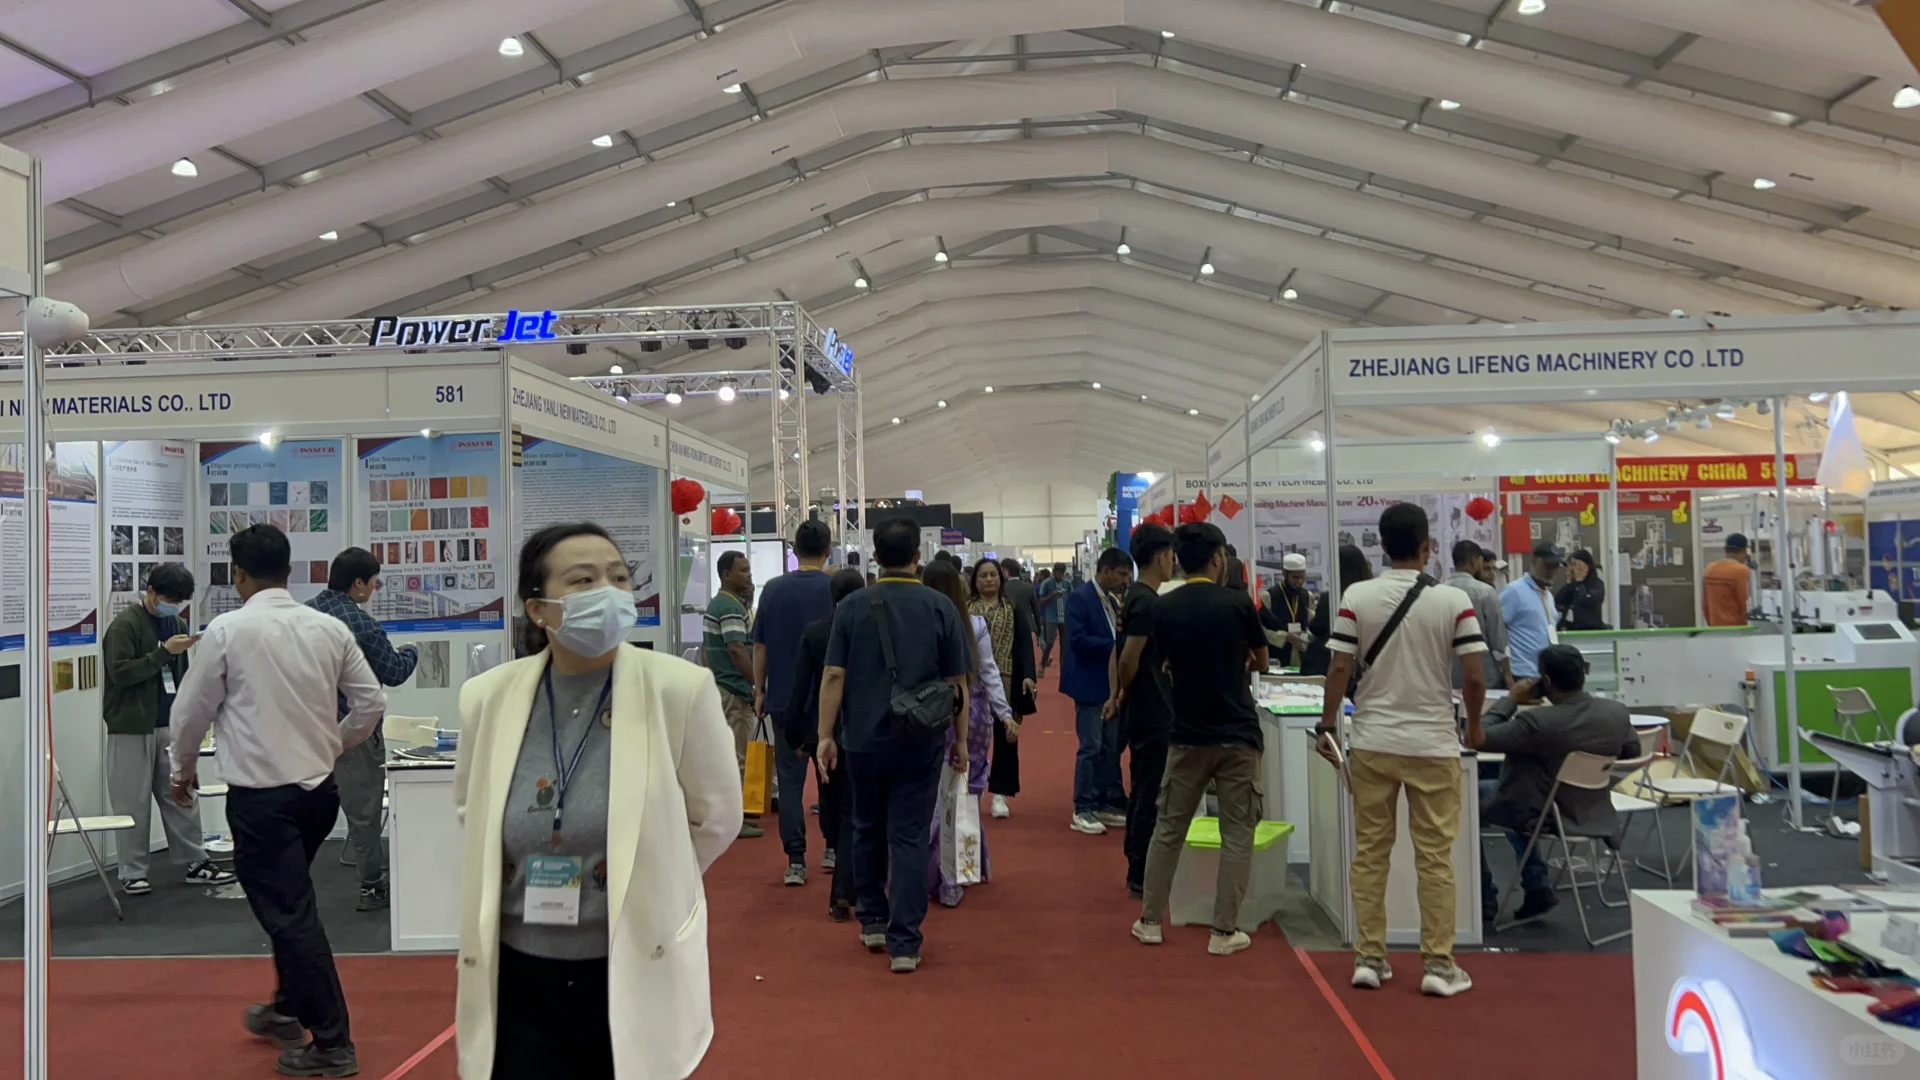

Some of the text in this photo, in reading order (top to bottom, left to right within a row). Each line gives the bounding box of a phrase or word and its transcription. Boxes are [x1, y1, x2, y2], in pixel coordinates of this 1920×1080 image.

[369, 309, 559, 346] Power Jet
[1349, 357, 1450, 377] ZHEJIANG
[1457, 354, 1530, 375] LIFENG
[1536, 350, 1658, 372] MACHINERY
[1664, 350, 1694, 368] CO
[52, 395, 152, 415] MATERIALS
[199, 393, 231, 411] LTD
[436, 385, 464, 403] 581
[513, 387, 542, 412] ZHEJIANG
[543, 397, 559, 417] YANLI
[559, 402, 571, 420] NEW
[571, 406, 598, 430] MATERIALS
[1697, 462, 1748, 480] CHINA
[1185, 480, 1219, 489] BOXIG
[1275, 500, 1305, 508] Machine
[1306, 499, 1353, 507] Manuturer
